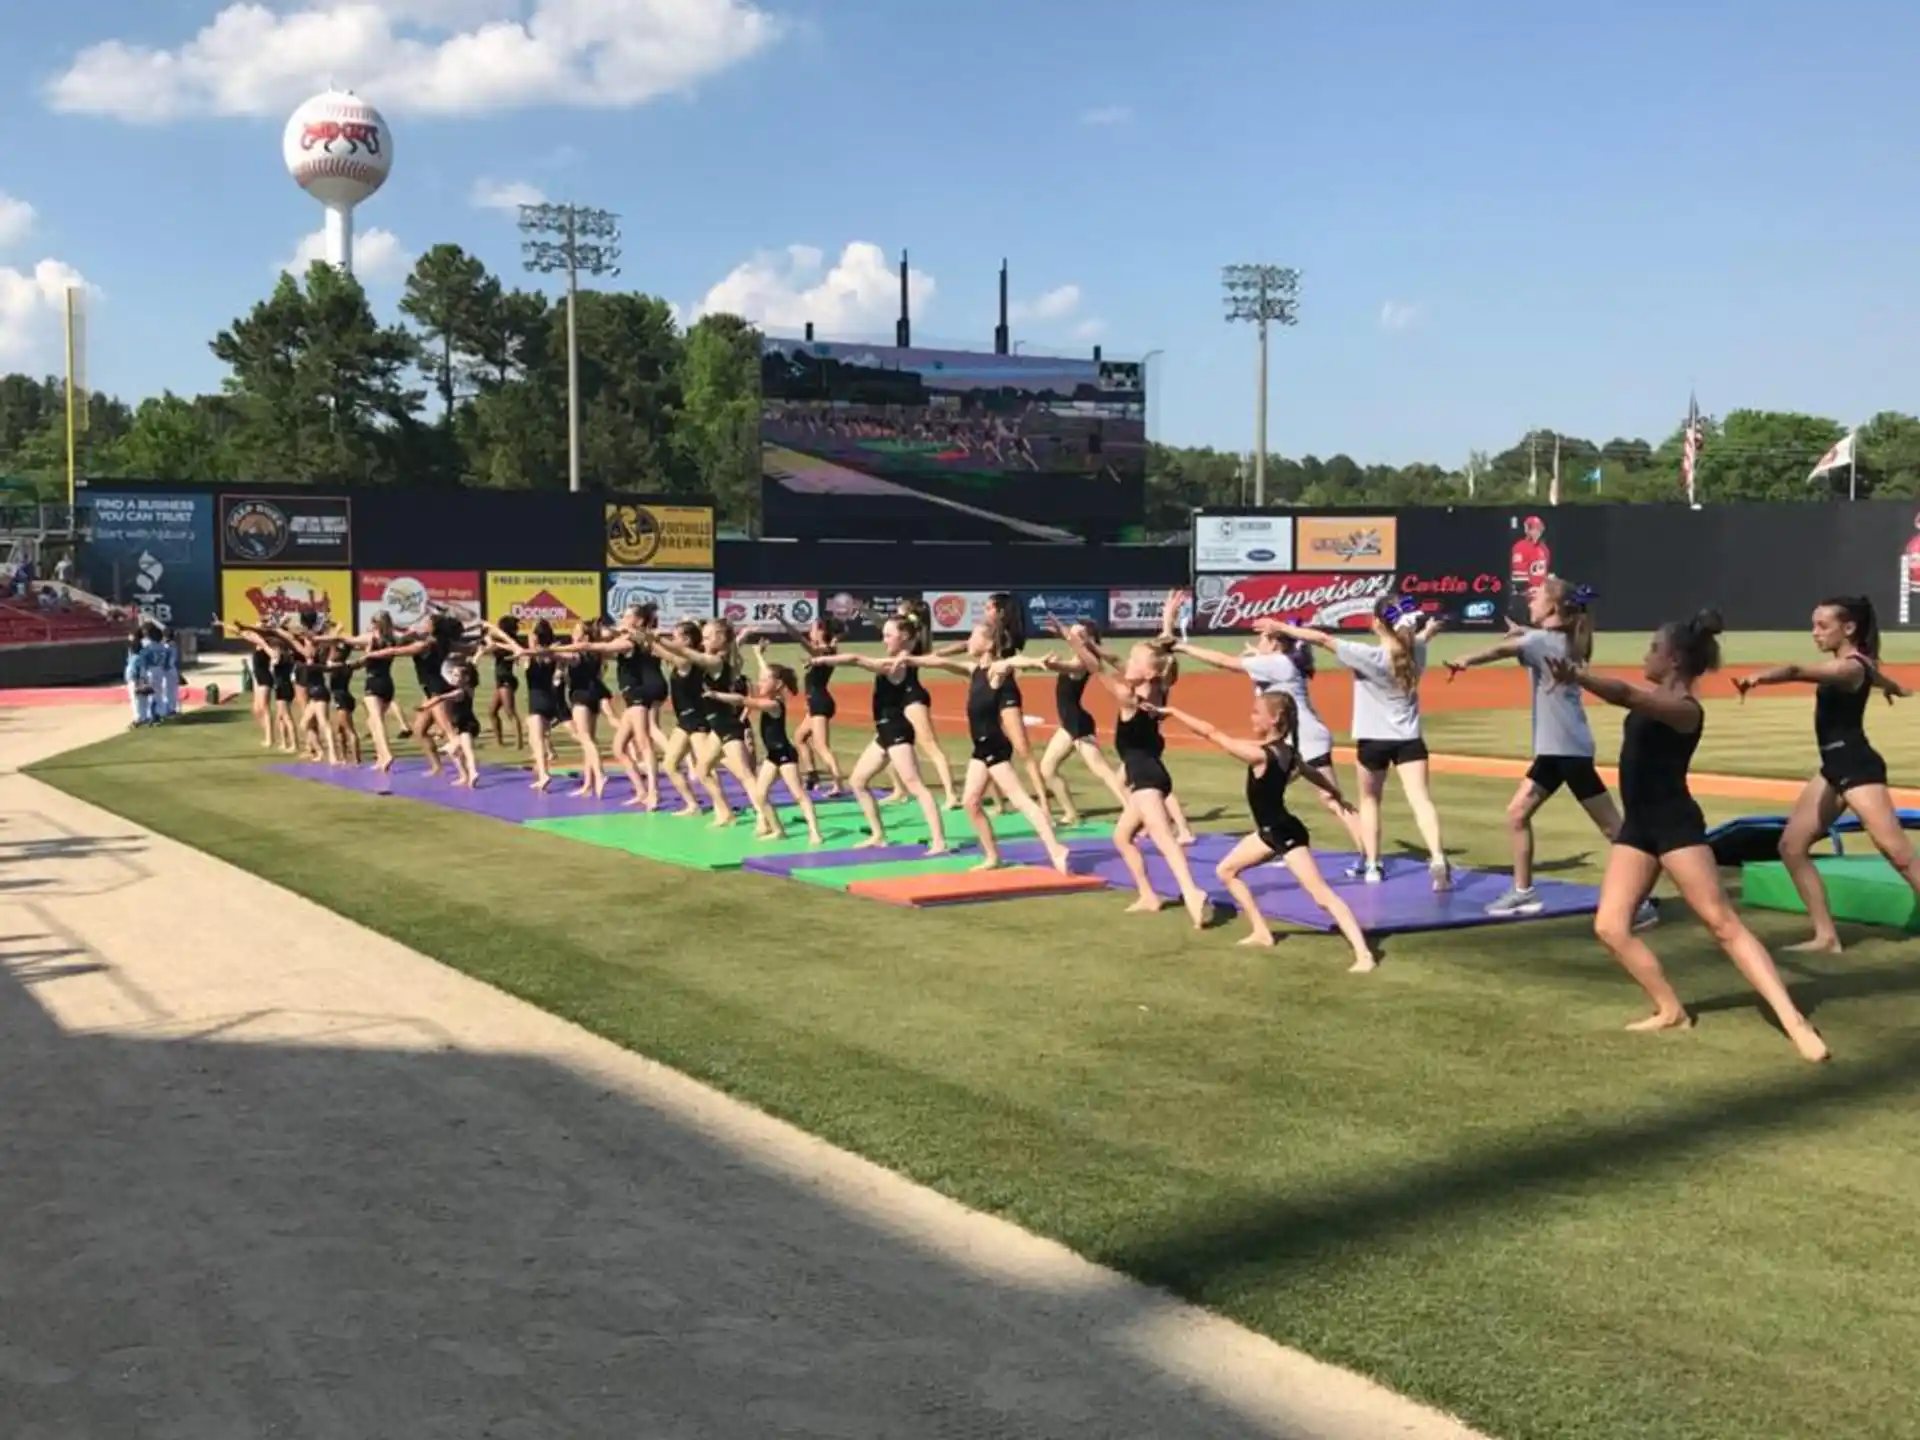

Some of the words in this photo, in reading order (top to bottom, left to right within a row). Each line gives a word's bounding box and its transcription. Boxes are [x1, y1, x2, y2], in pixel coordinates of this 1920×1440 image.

[96, 499, 123, 509] FIND
[127, 501, 135, 509] A
[138, 500, 194, 510] BUSINESS
[100, 512, 124, 521] YOU
[126, 512, 153, 521] CAN
[156, 512, 192, 521] TRUST
[660, 536, 711, 549] BREWING
[1208, 575, 1386, 630] Budweiser
